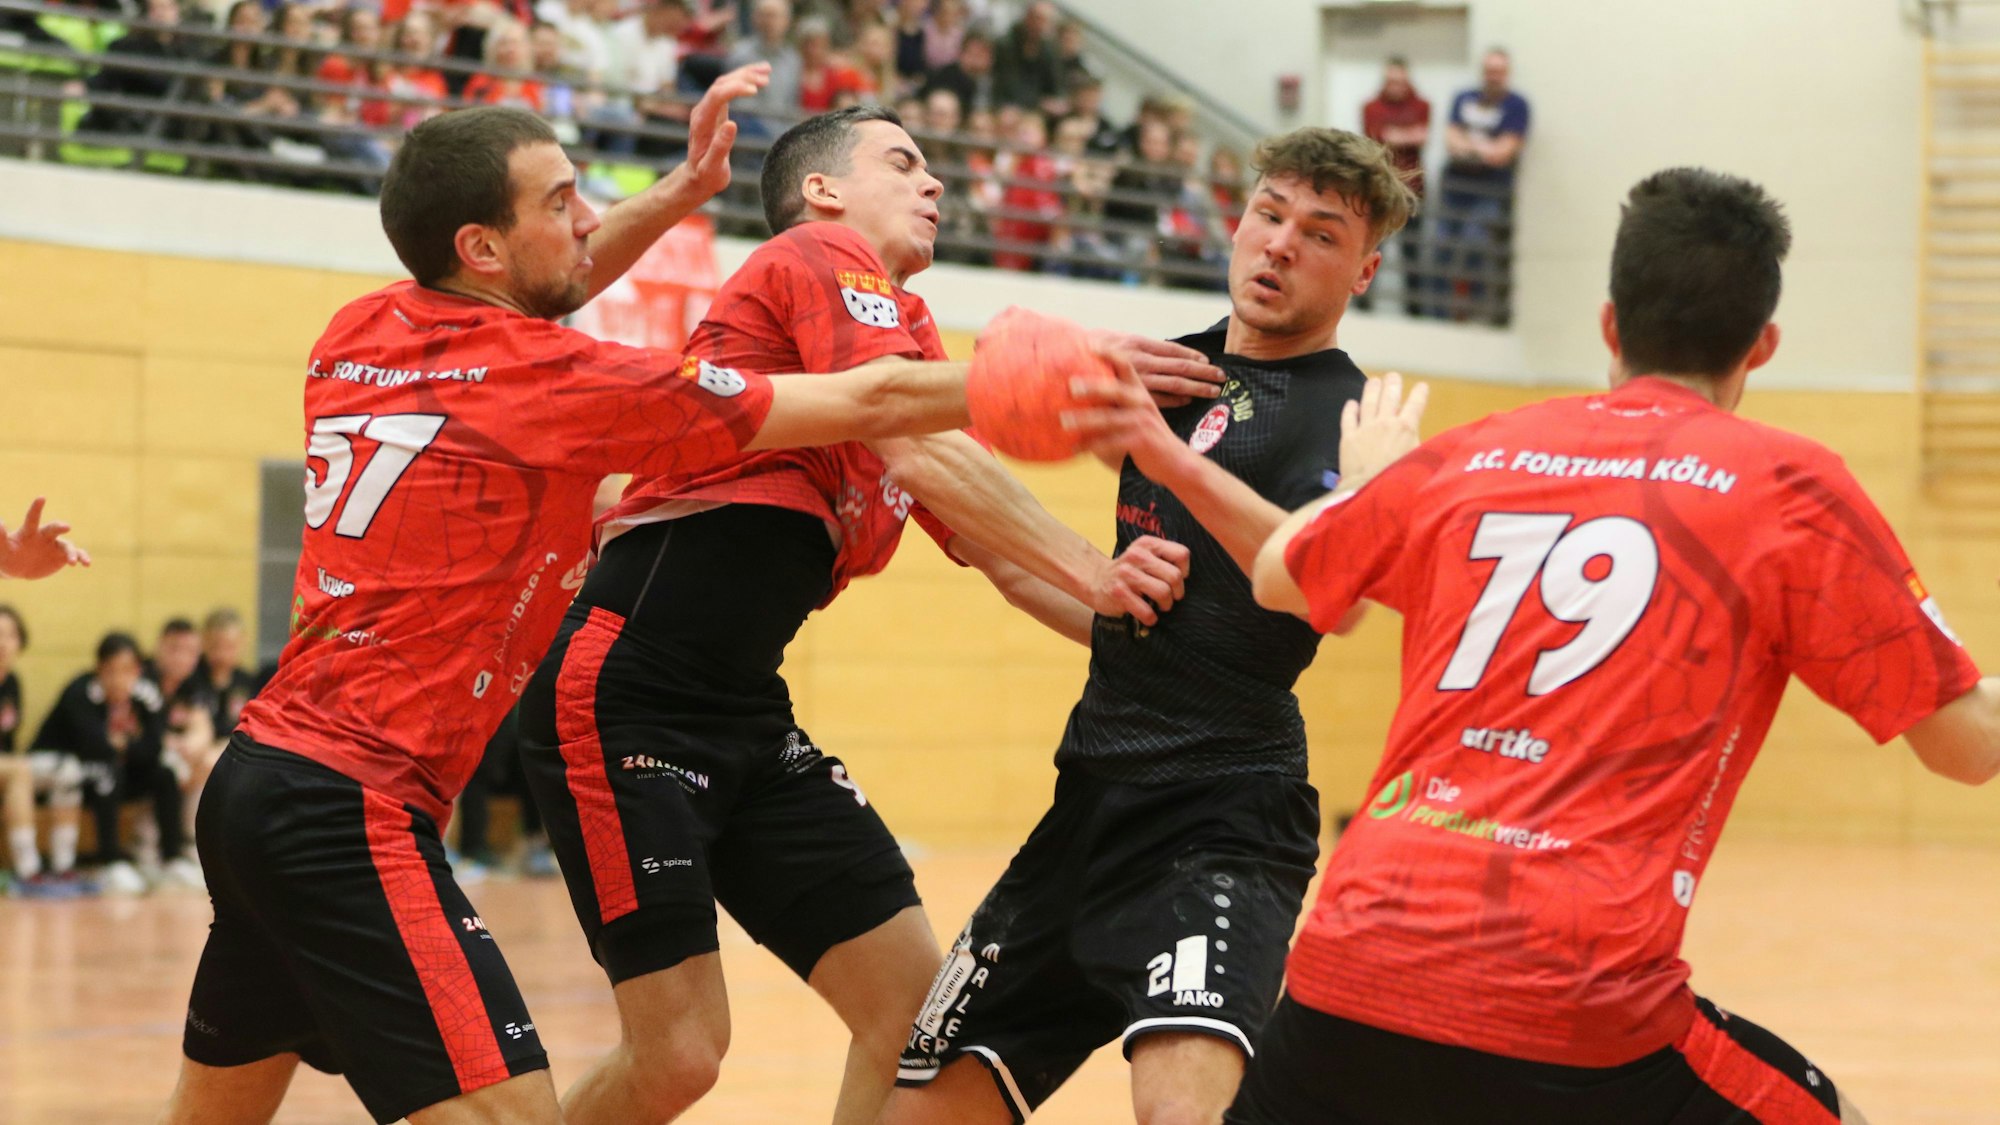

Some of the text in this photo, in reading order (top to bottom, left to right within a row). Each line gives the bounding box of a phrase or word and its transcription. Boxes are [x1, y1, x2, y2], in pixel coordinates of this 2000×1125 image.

[304, 412, 449, 540] 57
[1510, 450, 1647, 480] FORTUNA
[1650, 454, 1737, 494] KÖLN
[1436, 511, 1661, 697] 79
[1425, 776, 1461, 803] Die
[662, 858, 692, 868] spized
[1173, 990, 1225, 1009] JAKO
